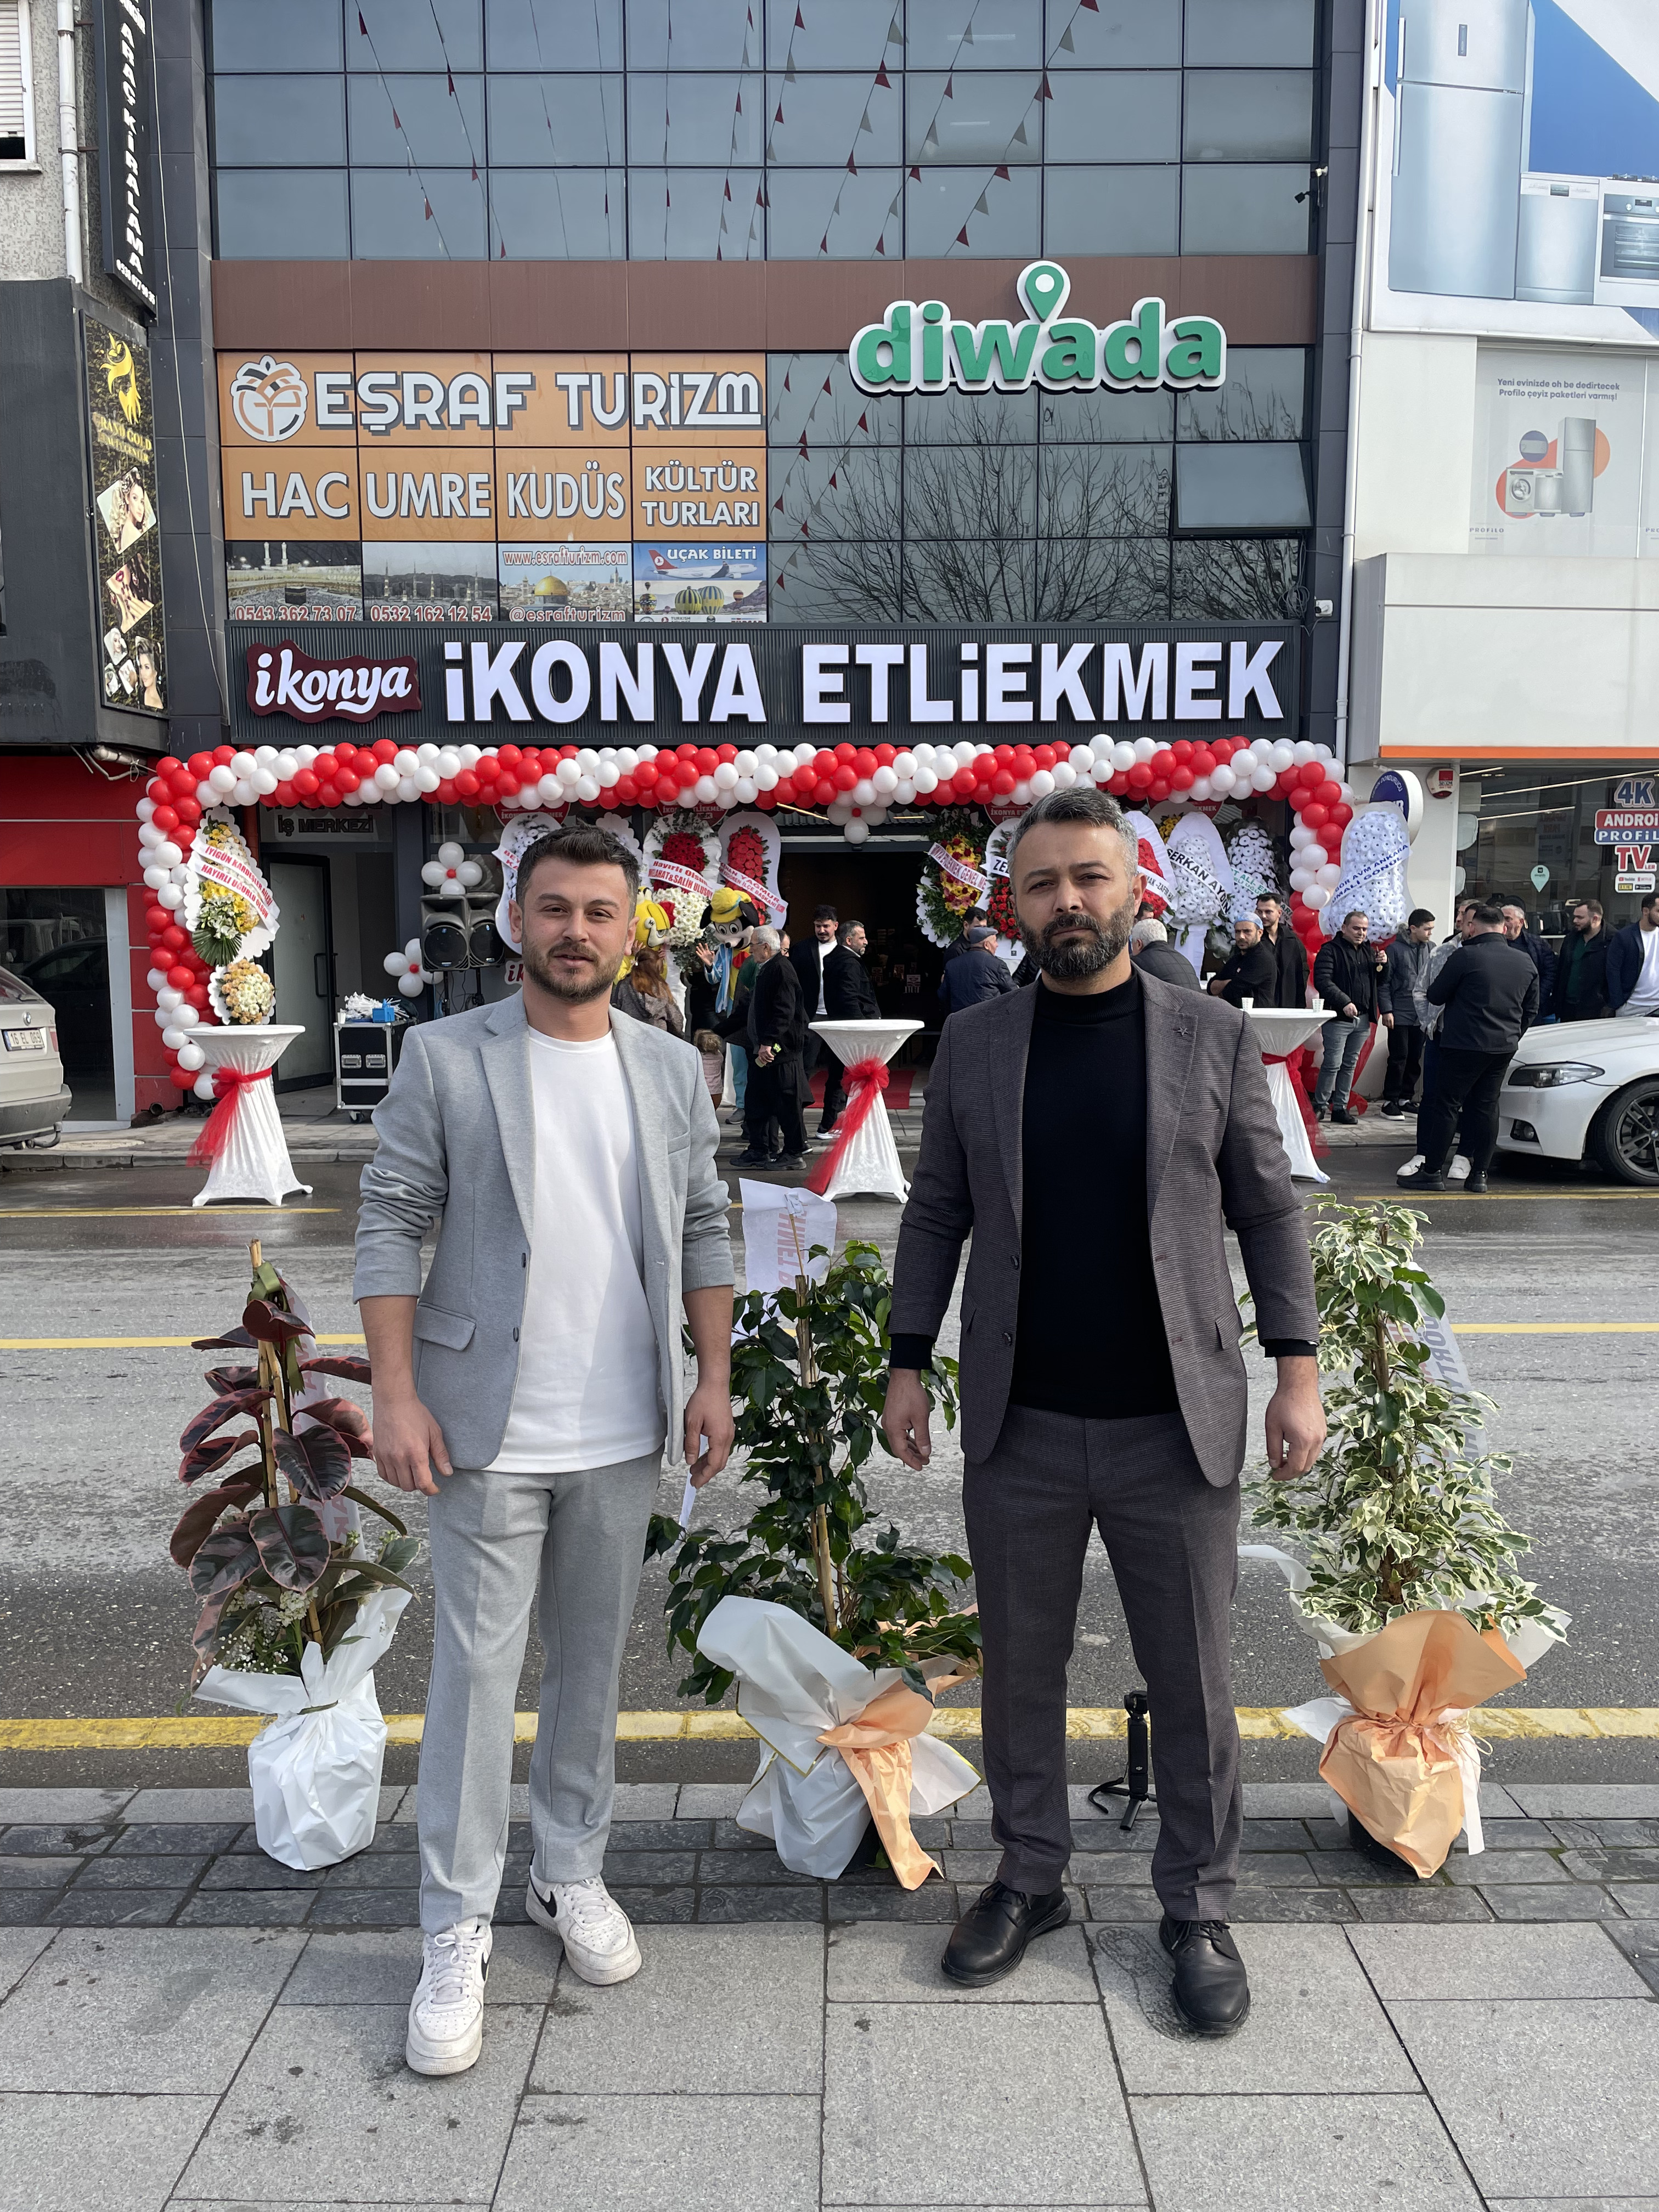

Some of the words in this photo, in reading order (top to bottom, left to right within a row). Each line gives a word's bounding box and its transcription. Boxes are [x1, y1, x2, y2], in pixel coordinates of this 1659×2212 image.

[121, 22, 137, 106] ARAÇ
[123, 108, 144, 274] KİRALAMA
[855, 301, 1222, 385] diwada
[1516, 379, 1550, 387] evinizde
[1576, 381, 1620, 390] dedirtecek
[1527, 390, 1549, 399] çeyiz
[1550, 390, 1587, 399] paketleri
[1588, 393, 1618, 402] varmış!
[314, 371, 535, 432] EŞRAF
[126, 428, 153, 451] GOLD
[644, 459, 758, 494] KÜLTÜR
[240, 471, 352, 520] HAC
[366, 471, 493, 520] UMRE
[507, 459, 627, 520] KUDÜS
[641, 500, 760, 527] TURLARI
[502, 546, 628, 566] www.esrafturizm.com
[667, 548, 709, 562] UÇAK
[712, 546, 757, 560] BİLETİ
[234, 605, 274, 621] 0543
[278, 605, 309, 621] 362
[312, 605, 332, 621] 73
[336, 605, 357, 621] 07
[370, 605, 411, 622] 0532
[414, 605, 444, 622] 162
[447, 605, 468, 622] 12
[471, 605, 493, 622] 54
[509, 606, 626, 622] @esrafturizm
[256, 650, 411, 716] ikonya
[1617, 780, 1652, 805] 4K
[277, 814, 295, 837] İŞ
[298, 814, 374, 833] MERKEZİ
[205, 845, 233, 864] İYİGÜN
[232, 859, 263, 890] KARDEŞLER
[653, 861, 683, 873] Hayırlı
[1352, 866, 1372, 881] AVM
[1374, 844, 1408, 868] ANKARA
[1616, 847, 1650, 870] TV
[961, 867, 978, 886] GENEL
[1166, 848, 1210, 881] SERKAN
[1209, 880, 1232, 915] AYDIN
[201, 864, 232, 884] HAYIRLI
[231, 879, 256, 902] UĞURLU
[256, 899, 269, 919] OLSUN
[693, 884, 714, 899] ULUSOY
[10, 1032, 19, 1045] 16
[20, 1032, 29, 1045] EL
